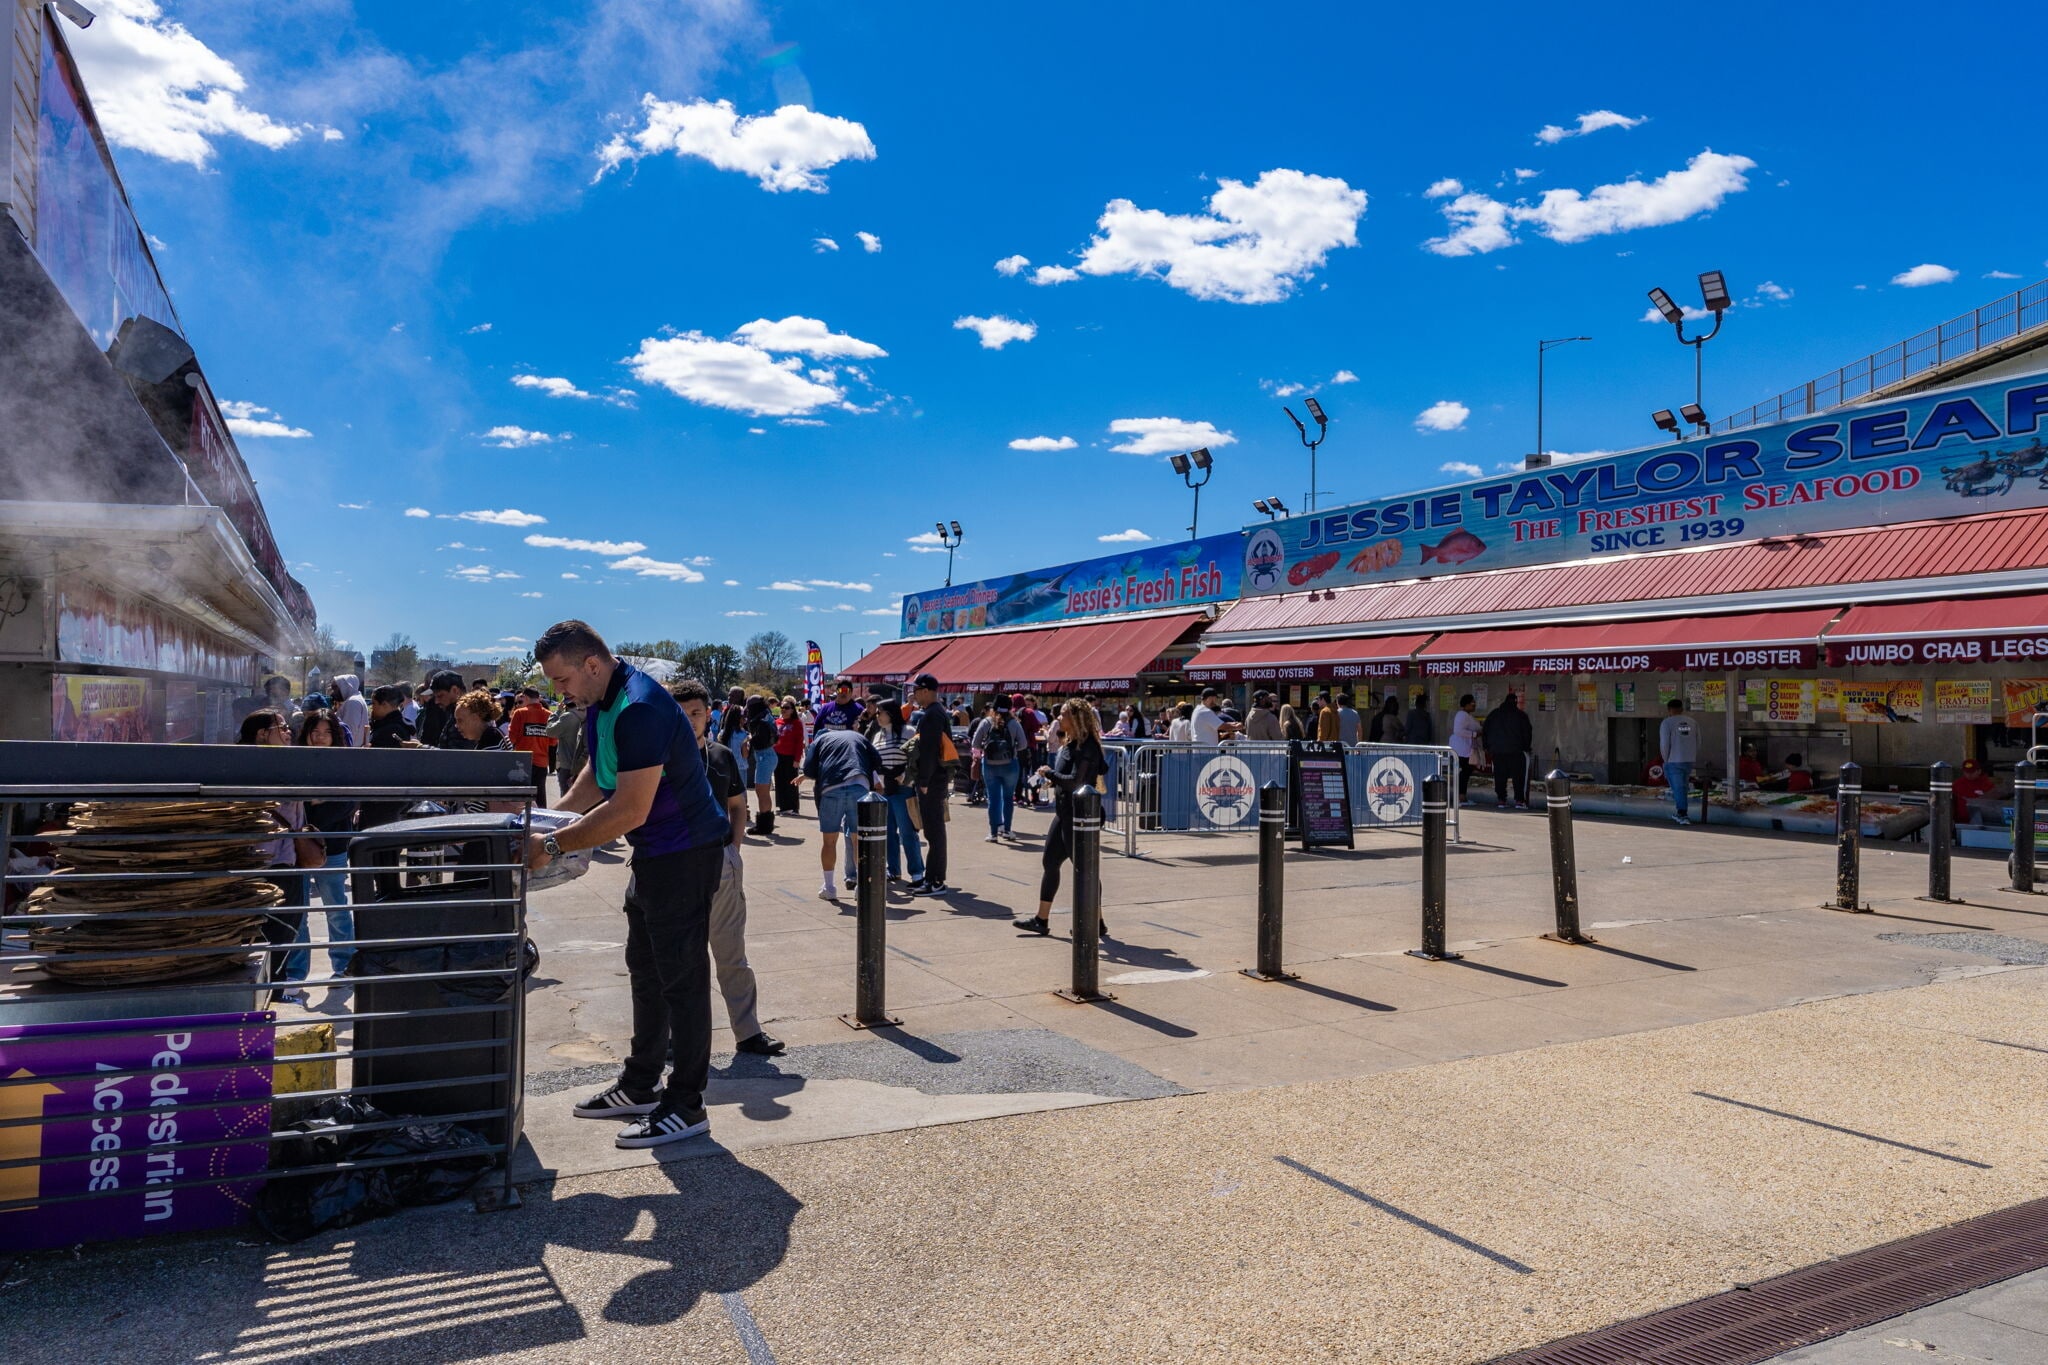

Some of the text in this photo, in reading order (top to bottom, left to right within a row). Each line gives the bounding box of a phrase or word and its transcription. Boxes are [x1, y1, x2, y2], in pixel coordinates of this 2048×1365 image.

[1299, 491, 1464, 549] JESSIE
[1472, 440, 1764, 520] TAYLOR
[1590, 517, 1745, 553] SINCE 1939
[1064, 560, 1222, 614] Jessie's Fresh Fish
[943, 591, 969, 609] Seafood
[969, 588, 998, 605] Dinners
[1845, 638, 2048, 661] JUMBO CRAB LEGS
[1533, 655, 1650, 671] FRESH SCALLOPS
[1685, 649, 1801, 667] LIVE LOBSTER
[1241, 666, 1314, 679] SHUCKED OYSTERS
[1333, 664, 1400, 676] FRESH FILLETS
[1426, 660, 1505, 674] FRESH SHRIMP
[1189, 670, 1227, 681] FRESH FISH
[1090, 680, 1110, 690] JUMBO
[1110, 680, 1129, 689] CRABS
[1971, 687, 1989, 696] BEST
[1939, 696, 1989, 705] CRAY FISH
[89, 1062, 135, 1192] Access
